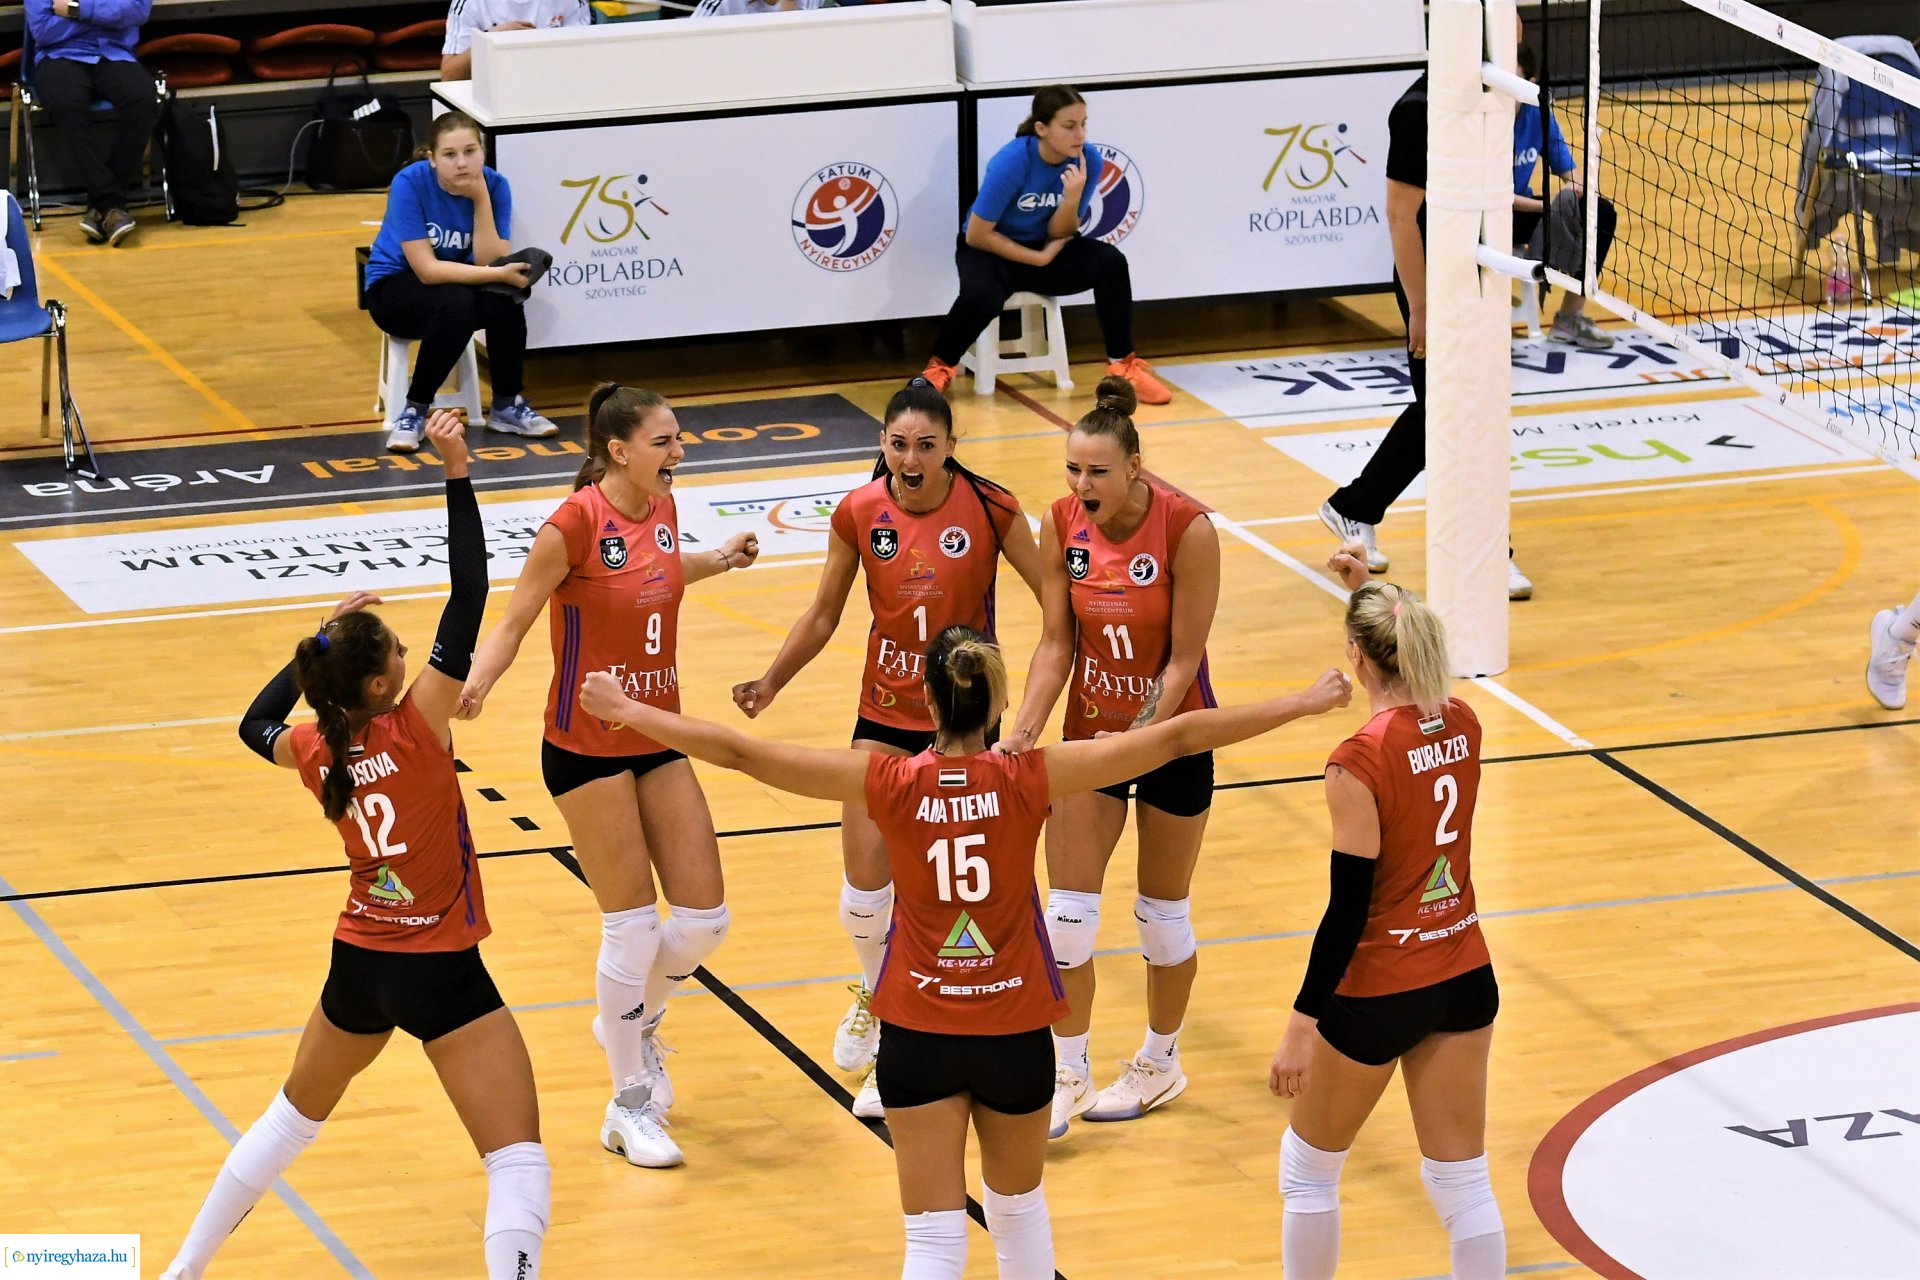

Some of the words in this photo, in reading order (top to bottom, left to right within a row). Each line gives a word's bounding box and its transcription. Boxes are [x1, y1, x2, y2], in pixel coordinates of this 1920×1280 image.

[817, 164, 871, 183] FATUM
[1290, 193, 1336, 205] MAGYAR
[1249, 205, 1379, 232] RÖPLABDA
[590, 245, 639, 259] MAGYAR
[1284, 232, 1344, 246] SZÖVETSÉG
[547, 257, 684, 287] RÖPLABDA
[585, 285, 647, 300] SZÖVETSÉG
[22, 461, 276, 500] Aréna
[645, 613, 662, 655] 9
[913, 606, 927, 641] 1
[1102, 624, 1134, 659] 11
[1407, 734, 1470, 775] BURAZER
[948, 791, 1000, 823] TIEMI
[1433, 774, 1459, 846] 2
[347, 793, 408, 858] 12
[926, 833, 991, 902] 15
[1417, 900, 1448, 915] KE-VIZ
[1419, 912, 1478, 942] BESTRONG
[937, 959, 979, 968] KE-VIZ
[979, 957, 994, 967] 21
[940, 976, 1023, 995] BESTRONG
